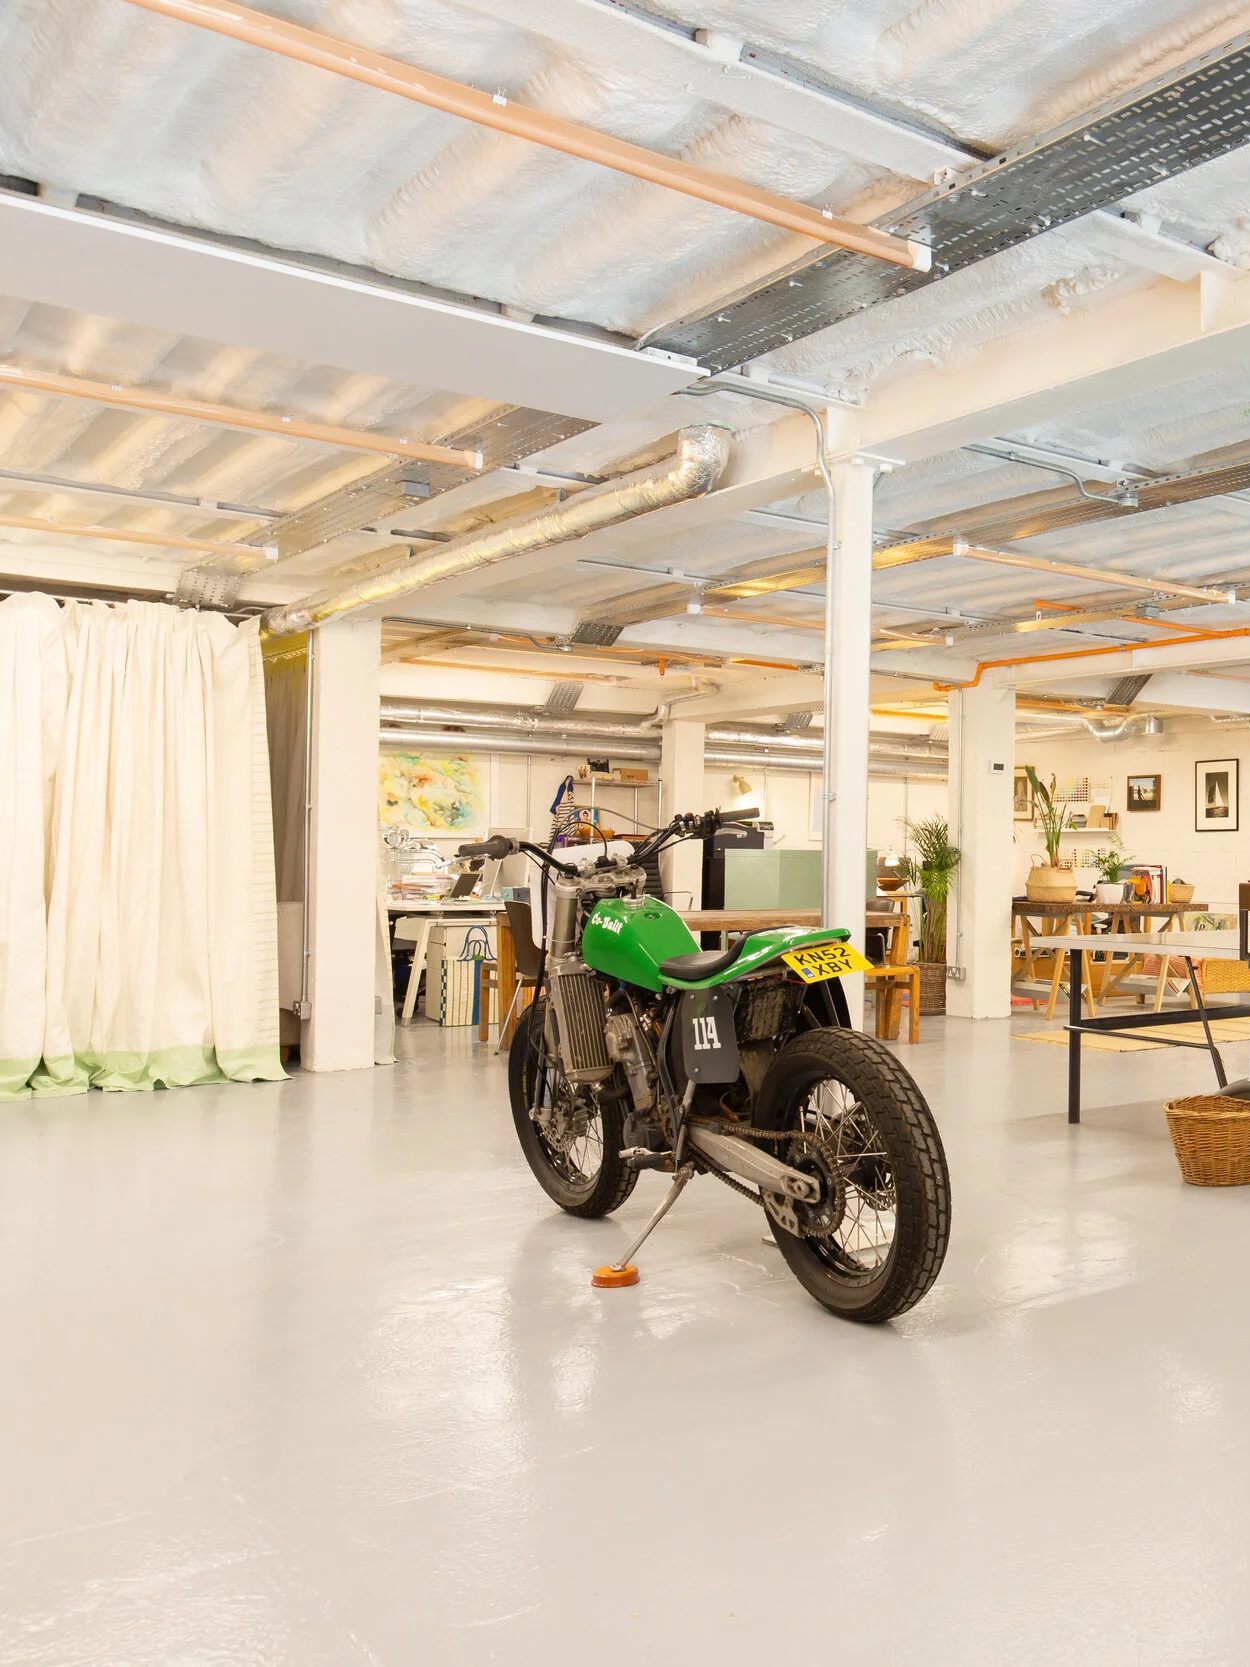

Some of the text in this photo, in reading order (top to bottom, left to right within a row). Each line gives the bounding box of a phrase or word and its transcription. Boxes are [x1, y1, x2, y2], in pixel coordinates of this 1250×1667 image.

[591, 911, 623, 935] Co-Built
[793, 947, 851, 966] KN52
[812, 959, 853, 976] XBY
[692, 1016, 722, 1050] 114
